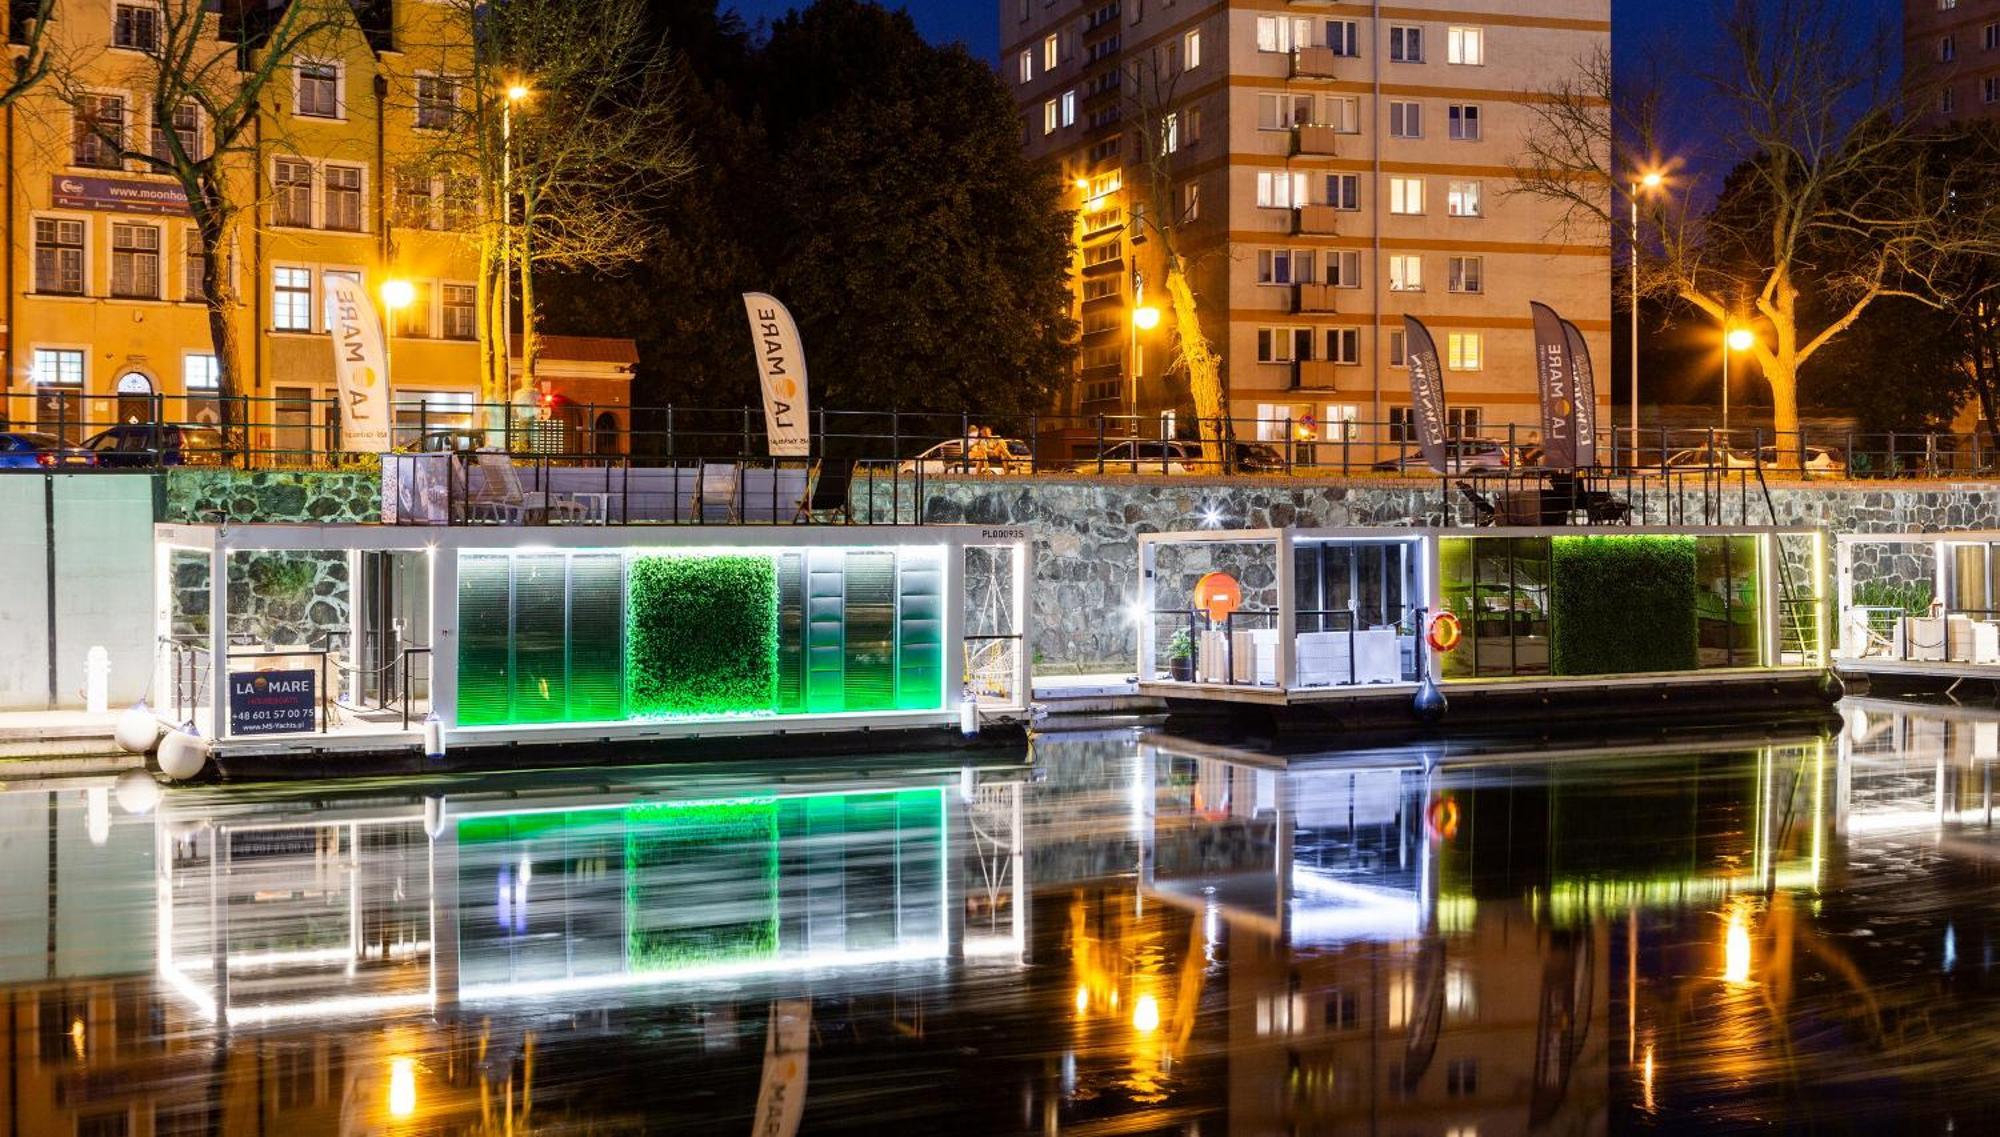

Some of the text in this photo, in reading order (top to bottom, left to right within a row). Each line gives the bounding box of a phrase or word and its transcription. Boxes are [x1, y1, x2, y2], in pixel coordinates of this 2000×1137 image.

[236, 680, 310, 695] LA MARE
[231, 708, 314, 720] +48 601 57 00 75
